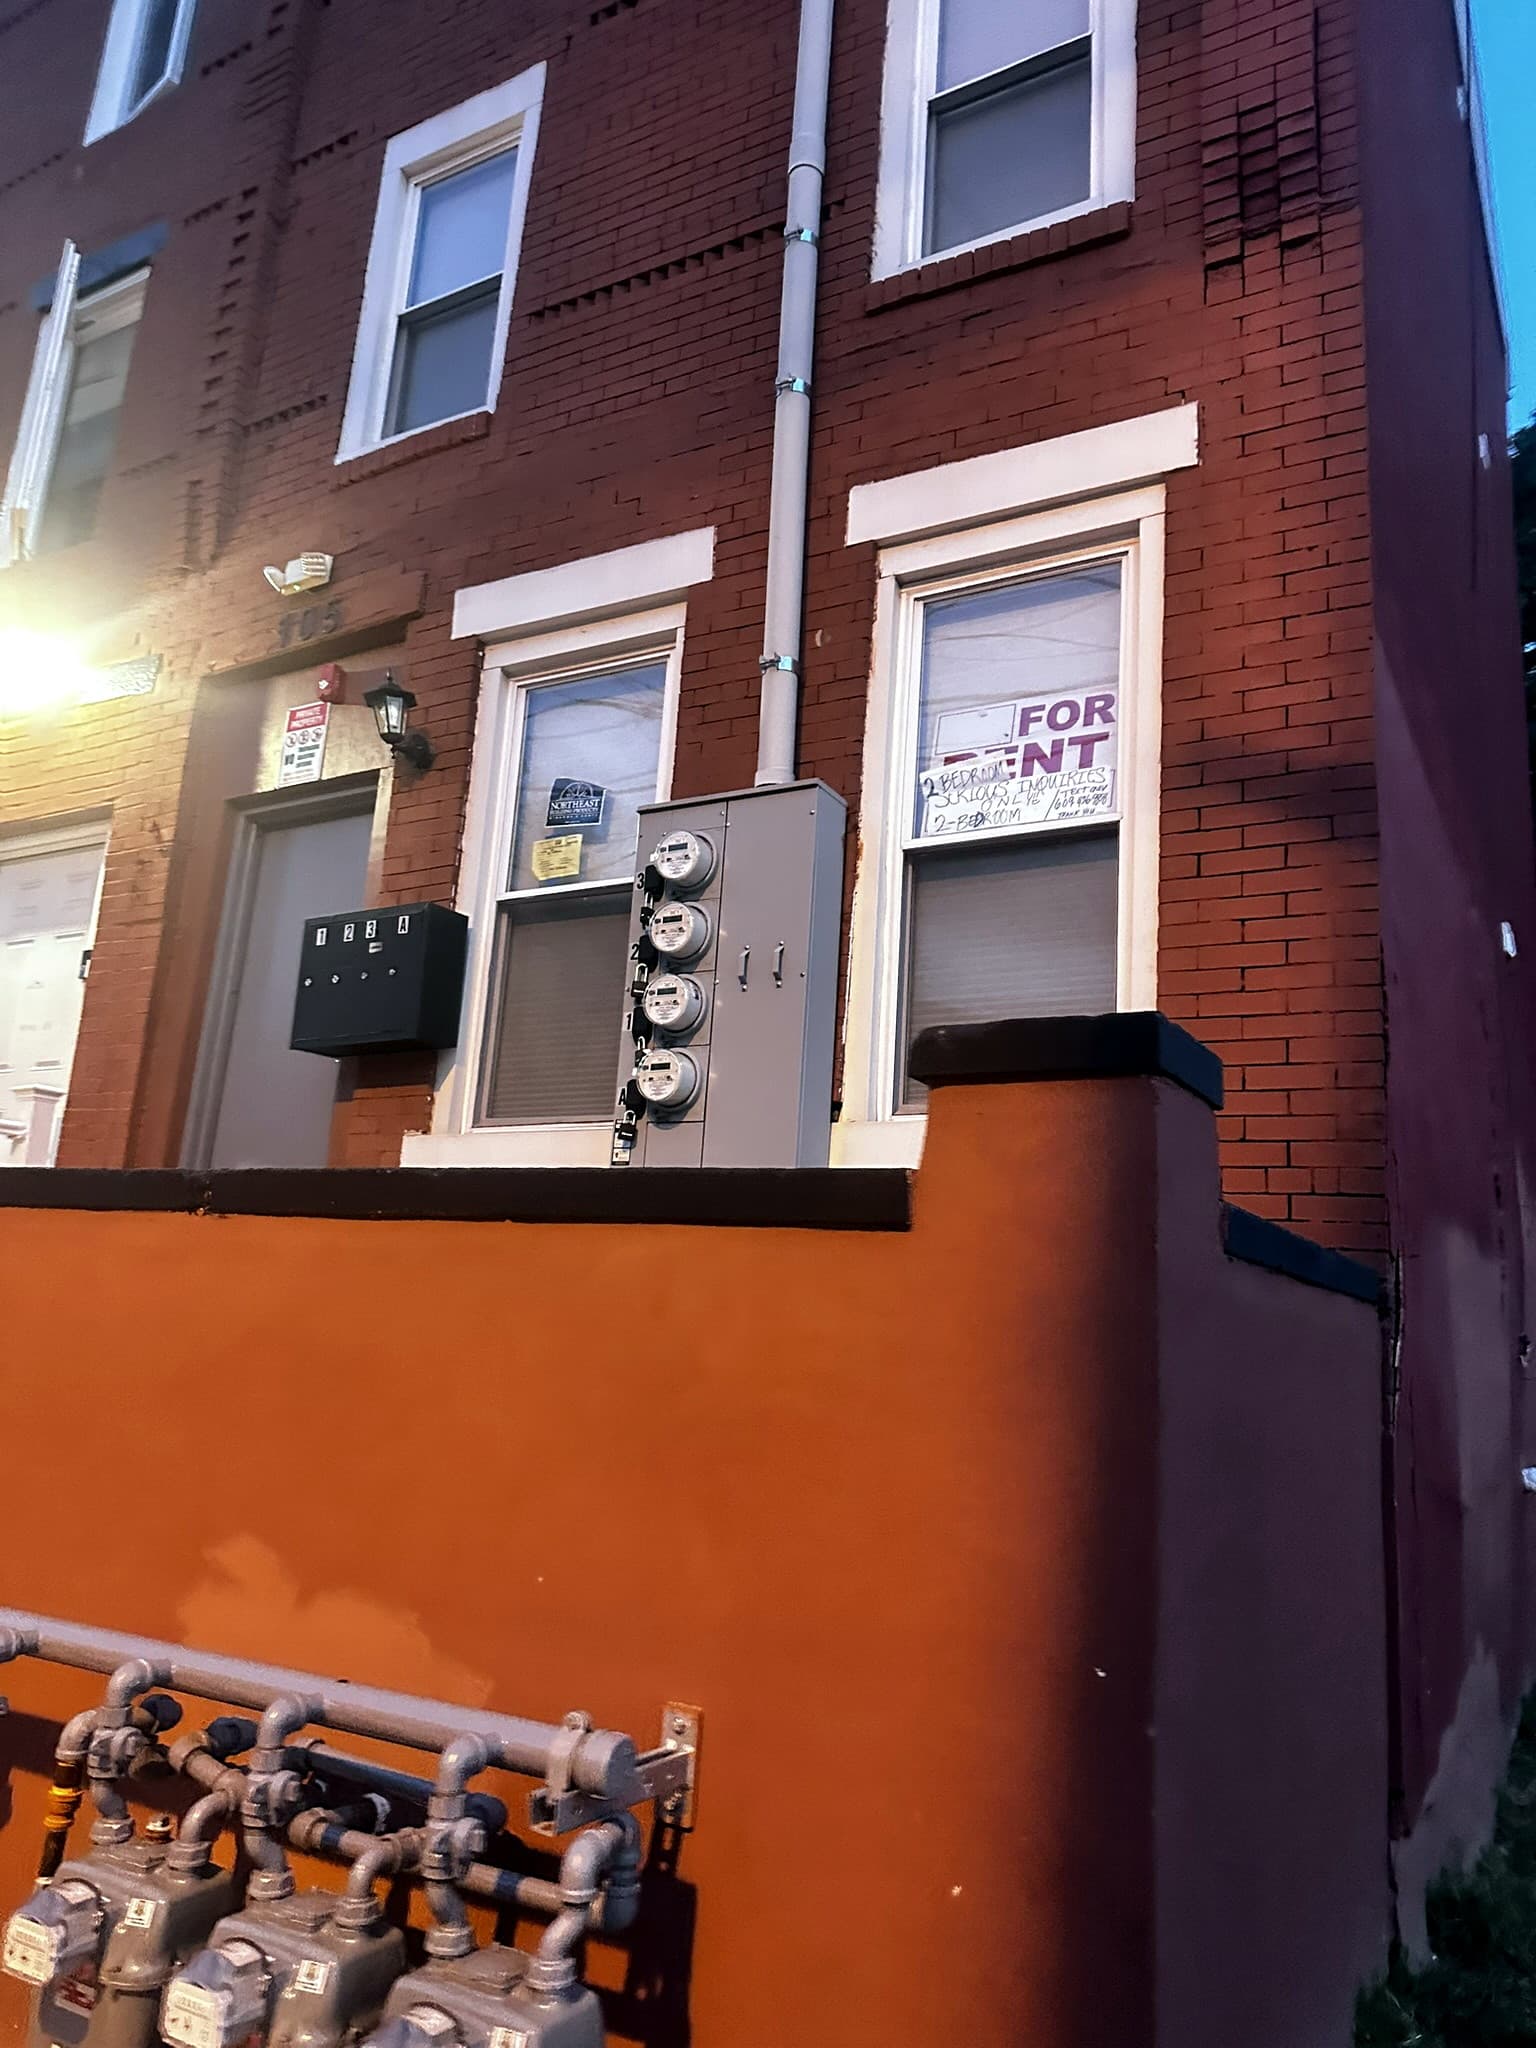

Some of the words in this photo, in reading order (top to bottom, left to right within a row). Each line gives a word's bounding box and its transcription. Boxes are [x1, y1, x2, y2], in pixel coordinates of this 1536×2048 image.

[1018, 693, 1116, 737] FOR
[943, 731, 1110, 780] NT
[923, 777, 939, 799] 2
[1017, 767, 1106, 795] INQUIRIES
[551, 799, 601, 810] NORTHEAST
[636, 872, 645, 890] 3
[399, 917, 407, 933] A
[630, 943, 640, 961] 2
[626, 1013, 632, 1030] 1
[618, 1087, 626, 1106] A
